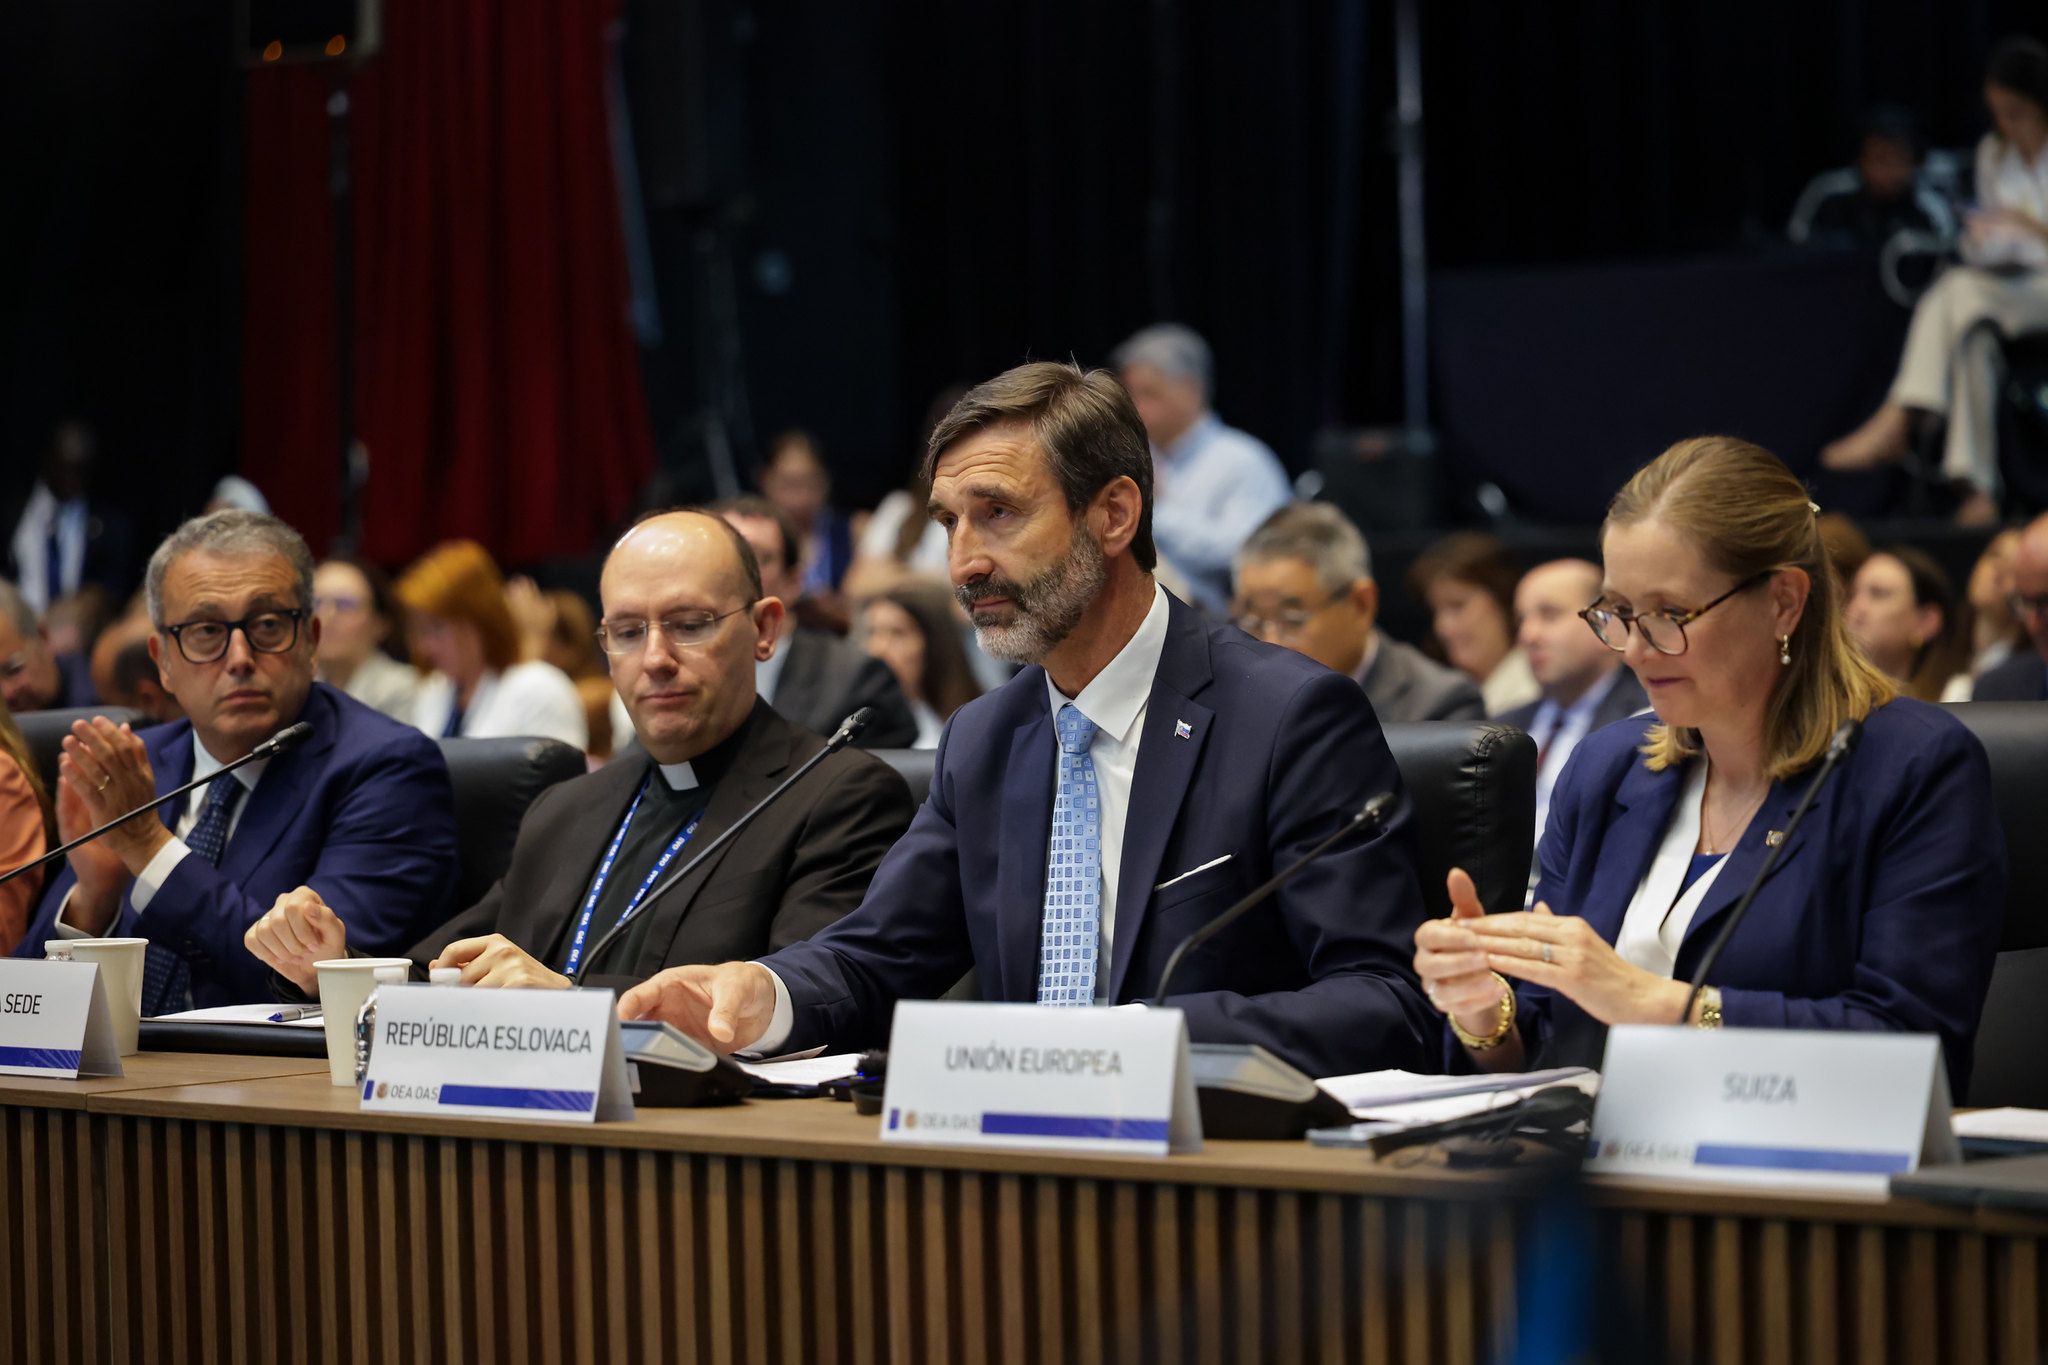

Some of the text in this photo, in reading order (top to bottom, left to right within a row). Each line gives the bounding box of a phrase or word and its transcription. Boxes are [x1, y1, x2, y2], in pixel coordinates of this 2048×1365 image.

[646, 870, 659, 884] OAS
[658, 853, 672, 867] OEA
[671, 836, 686, 851] OAS
[580, 912, 591, 926] OEA
[574, 930, 585, 944] OAS
[569, 949, 580, 963] OEA
[4, 993, 43, 1015] SEDE
[386, 1017, 593, 1054] REPÚBLICA ESLOVACA
[945, 1039, 1124, 1076] UNIÓN EUROPEA
[390, 1084, 439, 1101] OEA OAS
[1722, 1071, 1799, 1105] SUIZA
